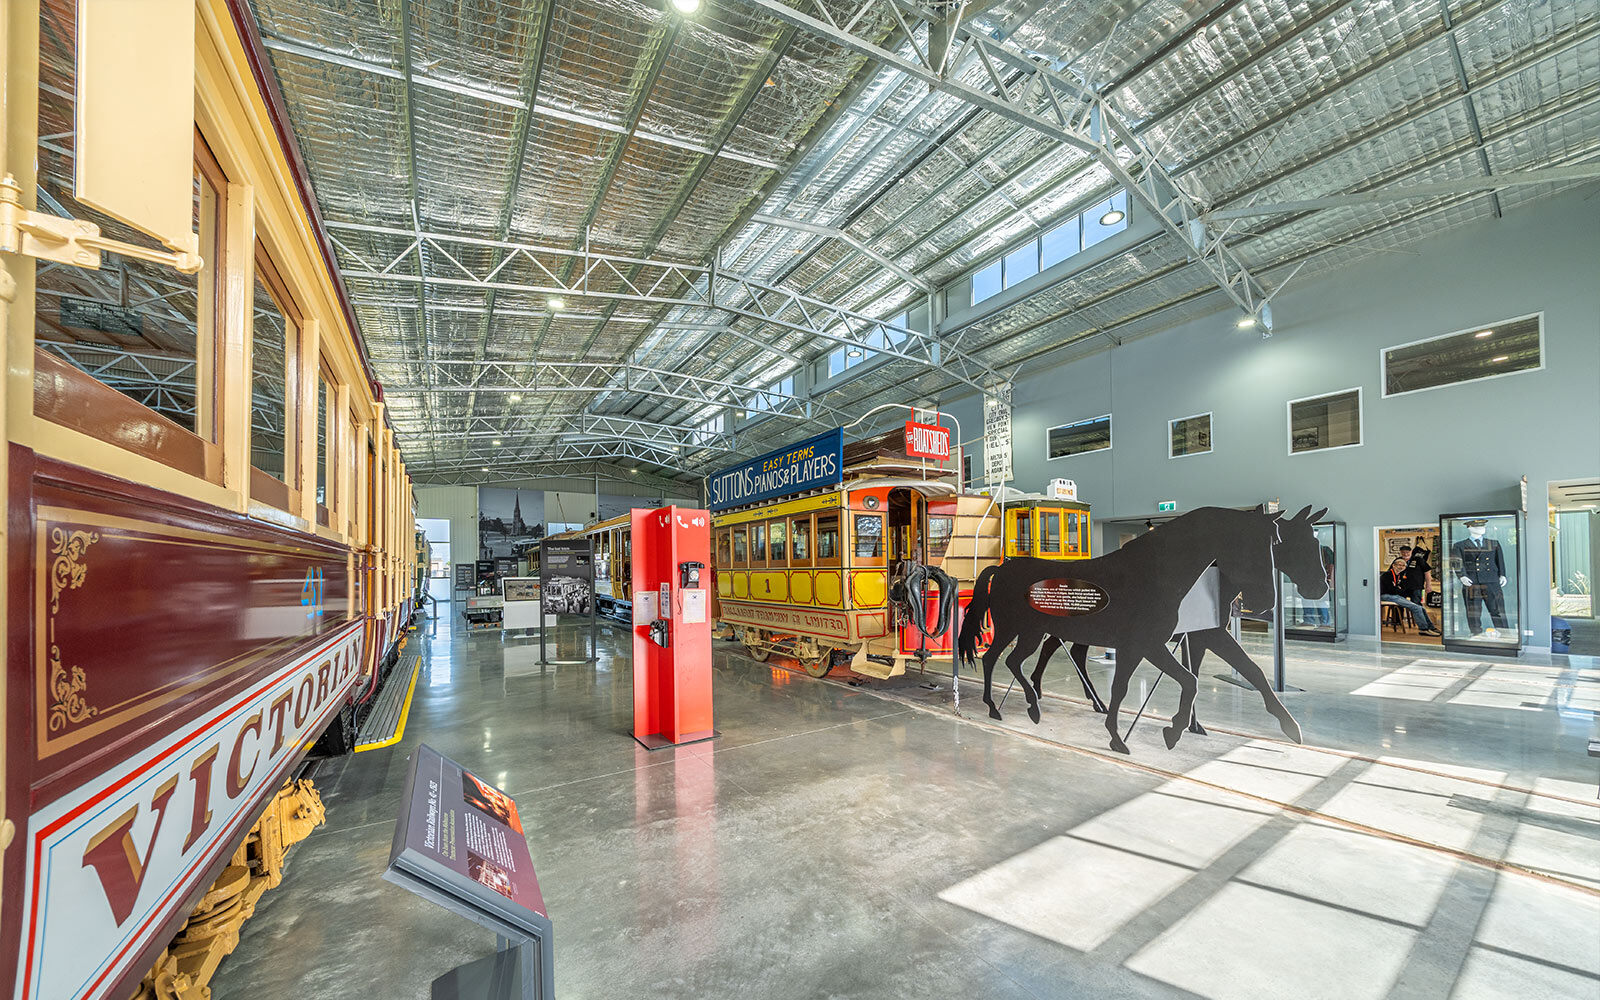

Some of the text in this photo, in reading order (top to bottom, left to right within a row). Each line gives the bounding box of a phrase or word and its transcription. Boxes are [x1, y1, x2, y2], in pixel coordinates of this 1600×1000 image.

[914, 427, 948, 456] BOATSHEDS
[763, 446, 814, 472] EASY TERMS
[301, 566, 323, 620] 41
[765, 579, 771, 593] 1
[756, 610, 788, 623] TRAMWAY
[82, 635, 361, 928] VICTORIAN
